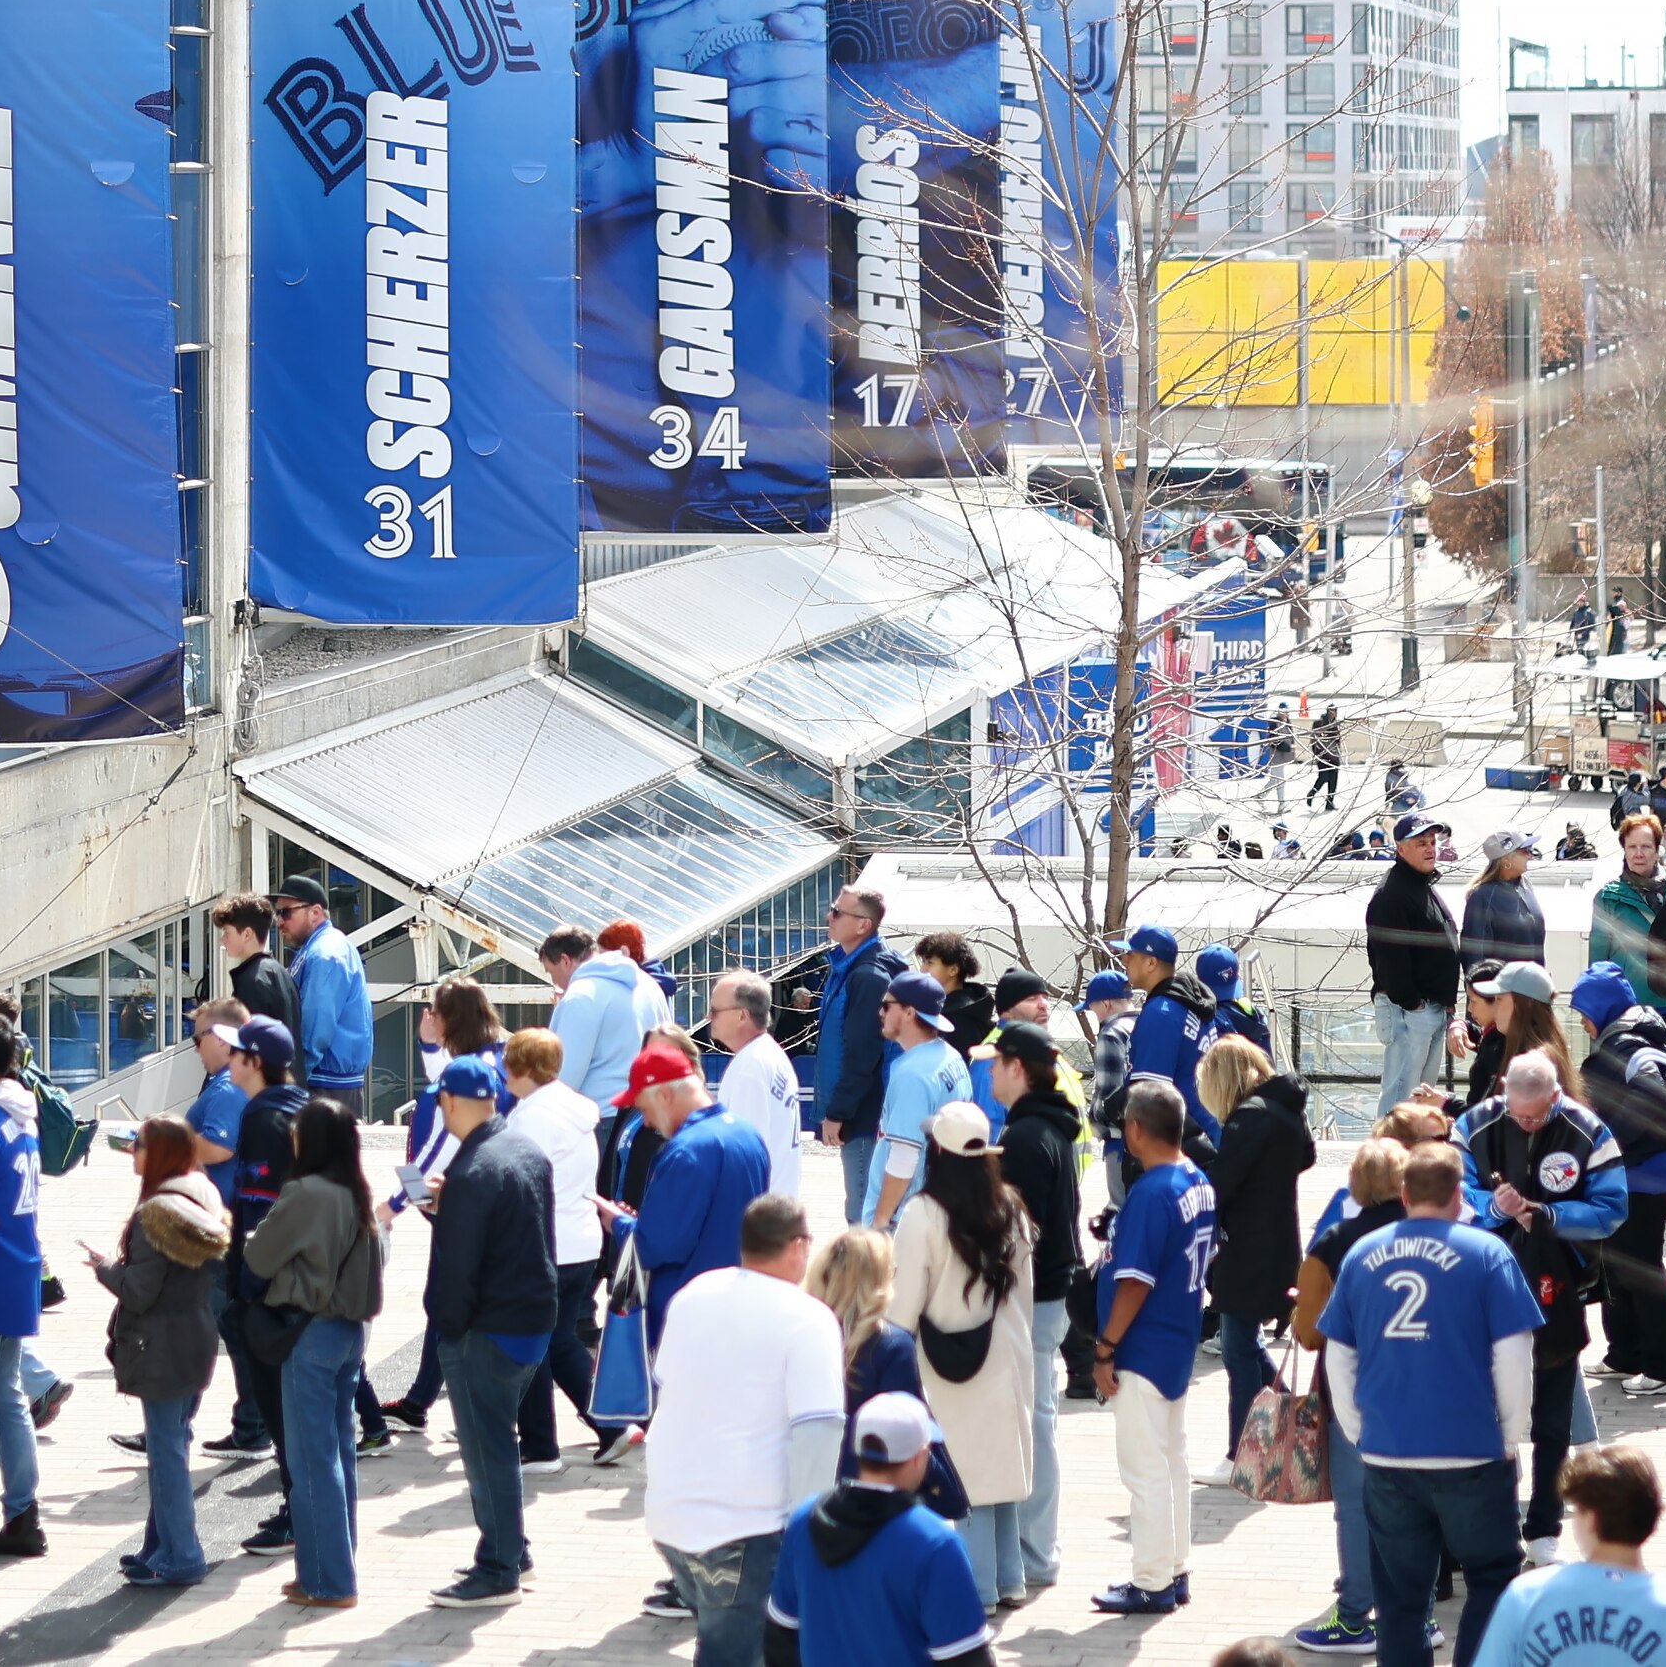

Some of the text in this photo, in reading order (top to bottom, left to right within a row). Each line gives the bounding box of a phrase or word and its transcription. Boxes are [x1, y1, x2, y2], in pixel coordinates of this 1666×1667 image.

[653, 67, 735, 399] GAUSMAN
[845, 124, 921, 366] BERRÍOS
[366, 90, 452, 478] SCHERZER
[853, 373, 921, 428] 17
[648, 405, 748, 470] 34
[363, 484, 457, 559] 31
[1214, 639, 1264, 661] THIRD
[1362, 1237, 1462, 1272] TULOWITZKI
[1384, 1270, 1428, 1338] 2
